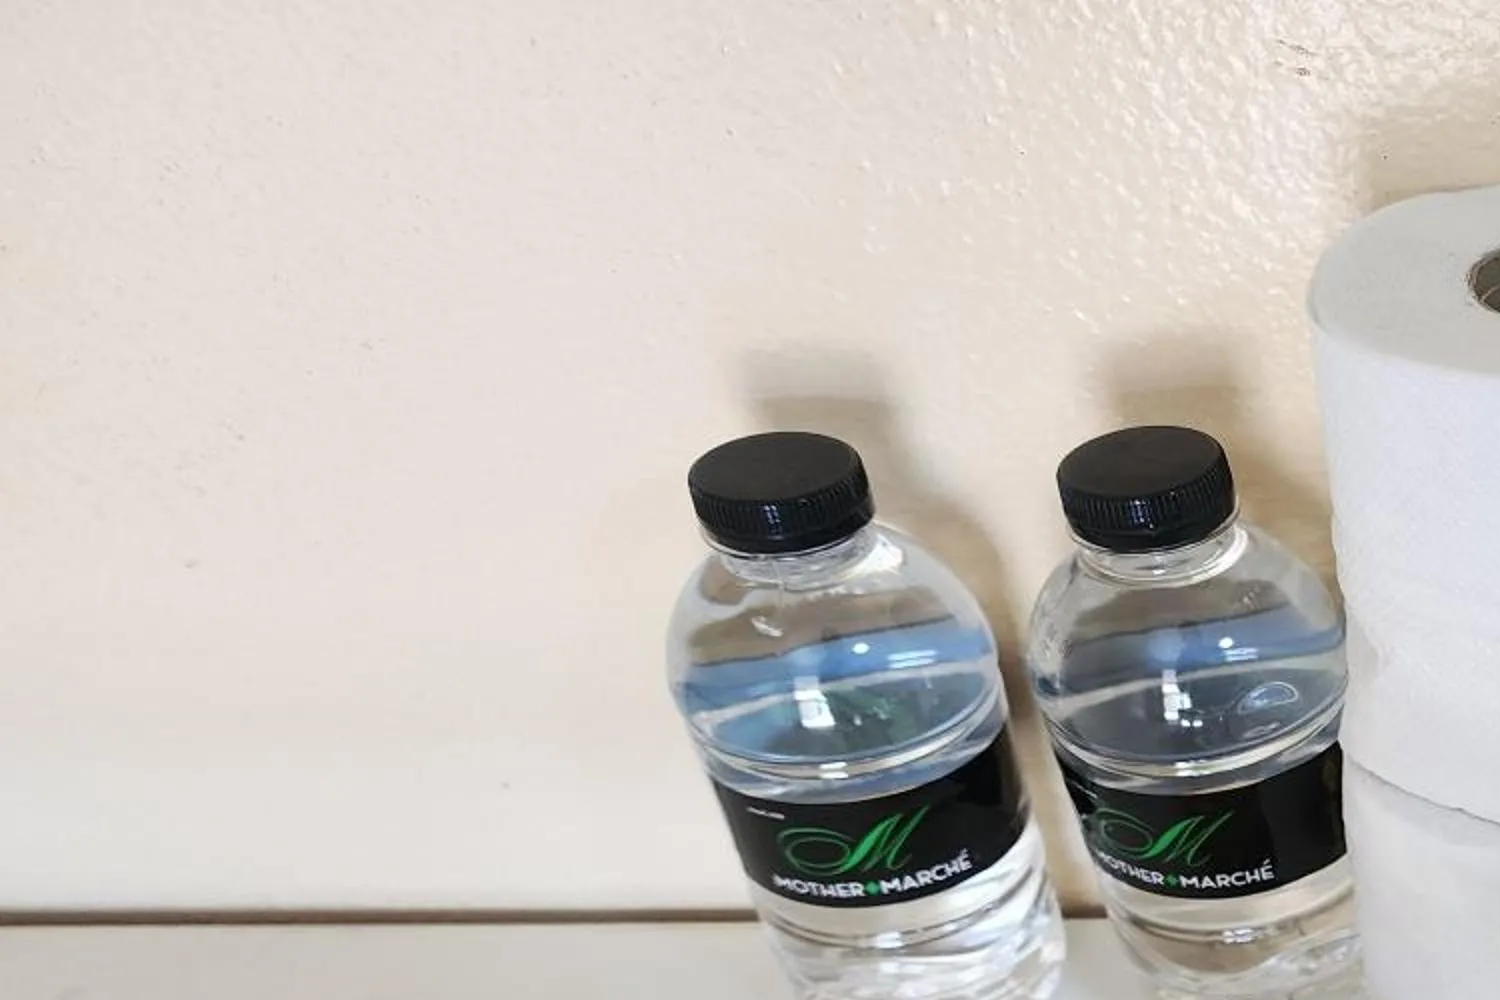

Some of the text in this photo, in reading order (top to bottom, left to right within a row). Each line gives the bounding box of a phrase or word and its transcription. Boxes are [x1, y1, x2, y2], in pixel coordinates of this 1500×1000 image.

[772, 848, 974, 899] MOTHER MARCHÉ
[1179, 858, 1276, 890] MARCHÉ
